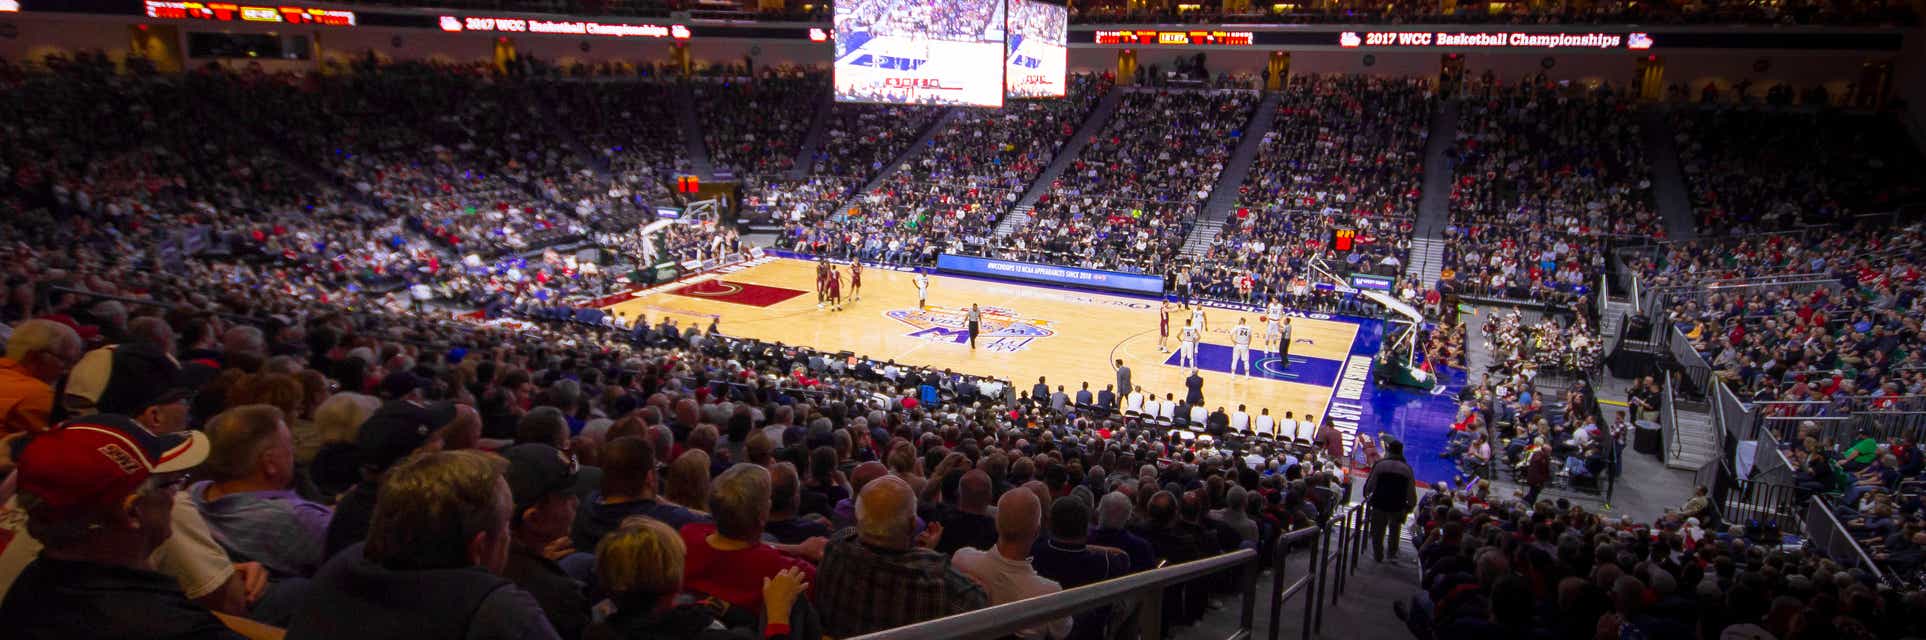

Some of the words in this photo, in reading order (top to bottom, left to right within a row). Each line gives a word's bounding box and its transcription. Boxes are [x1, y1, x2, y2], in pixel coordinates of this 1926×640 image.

[466, 17, 495, 31] 2017
[496, 19, 526, 32] WCC
[528, 20, 586, 34] Basketball
[586, 22, 668, 38] Championships
[1366, 32, 1397, 46] 2017
[1399, 32, 1432, 46] WCC
[1436, 33, 1507, 46] Basketball
[1509, 33, 1621, 49] Championships
[1022, 266, 1034, 274] NCAA
[1034, 267, 1065, 278] APPEARANCES
[1066, 271, 1079, 279] SINCE
[1239, 329, 1248, 337] 24
